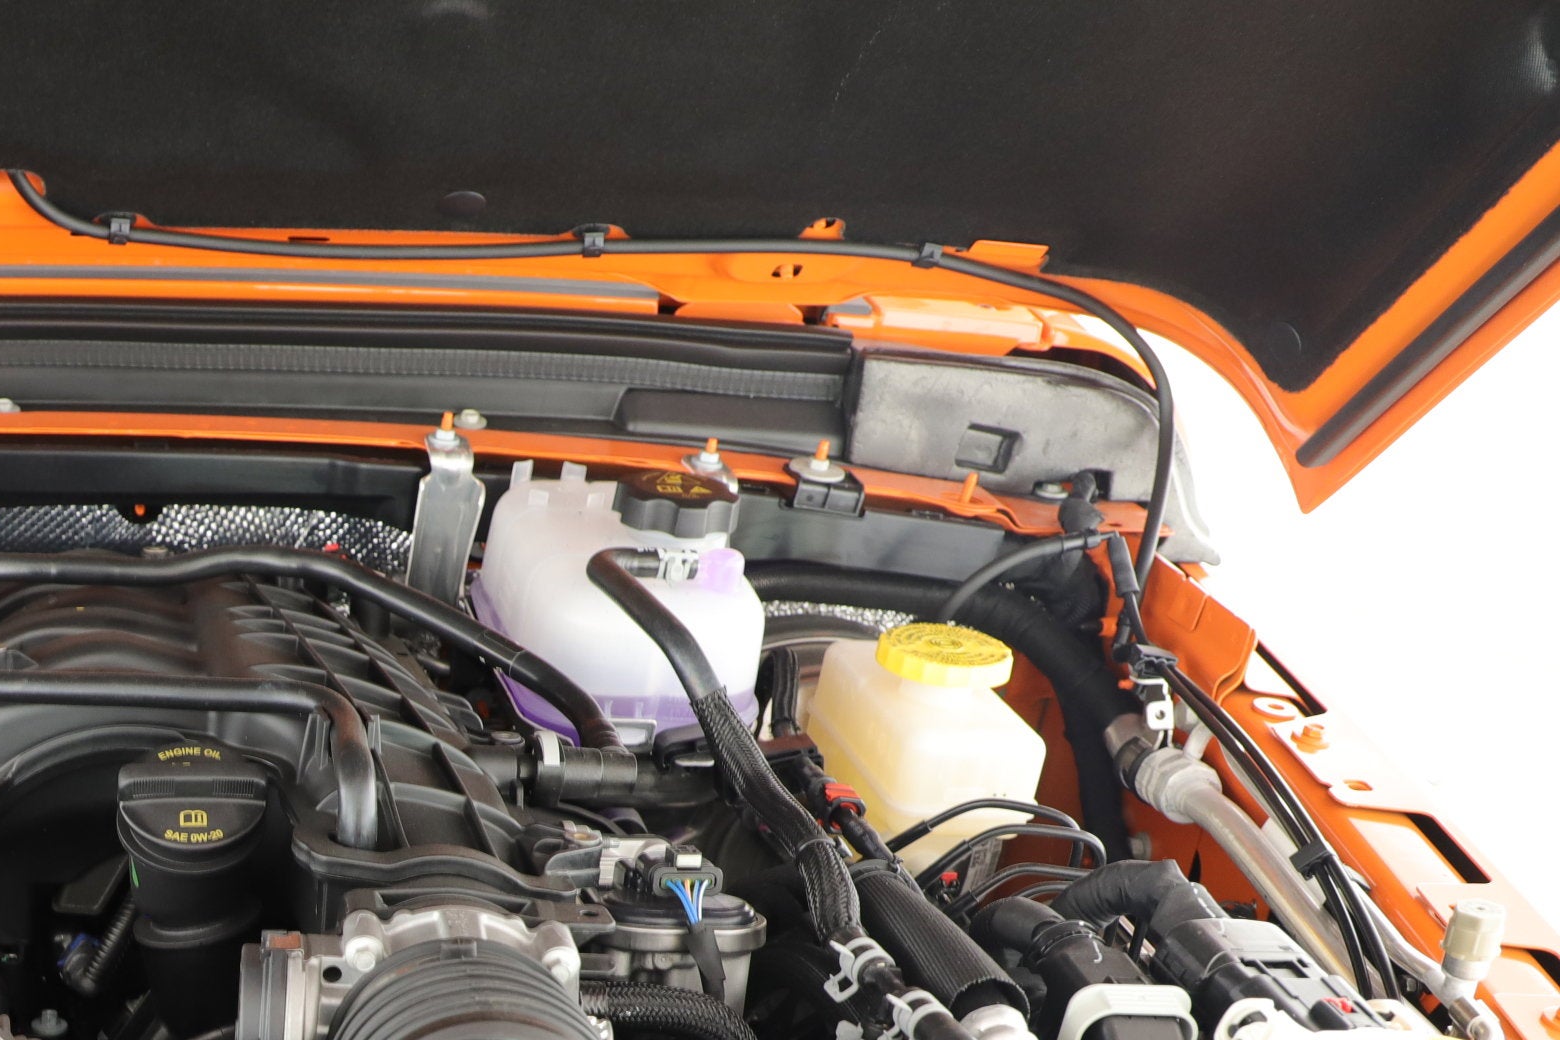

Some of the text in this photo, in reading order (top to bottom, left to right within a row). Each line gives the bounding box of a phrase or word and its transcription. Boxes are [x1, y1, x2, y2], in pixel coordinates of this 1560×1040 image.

[158, 747, 222, 761] ENGINE OIL
[164, 829, 224, 843] SAE 0W-20
